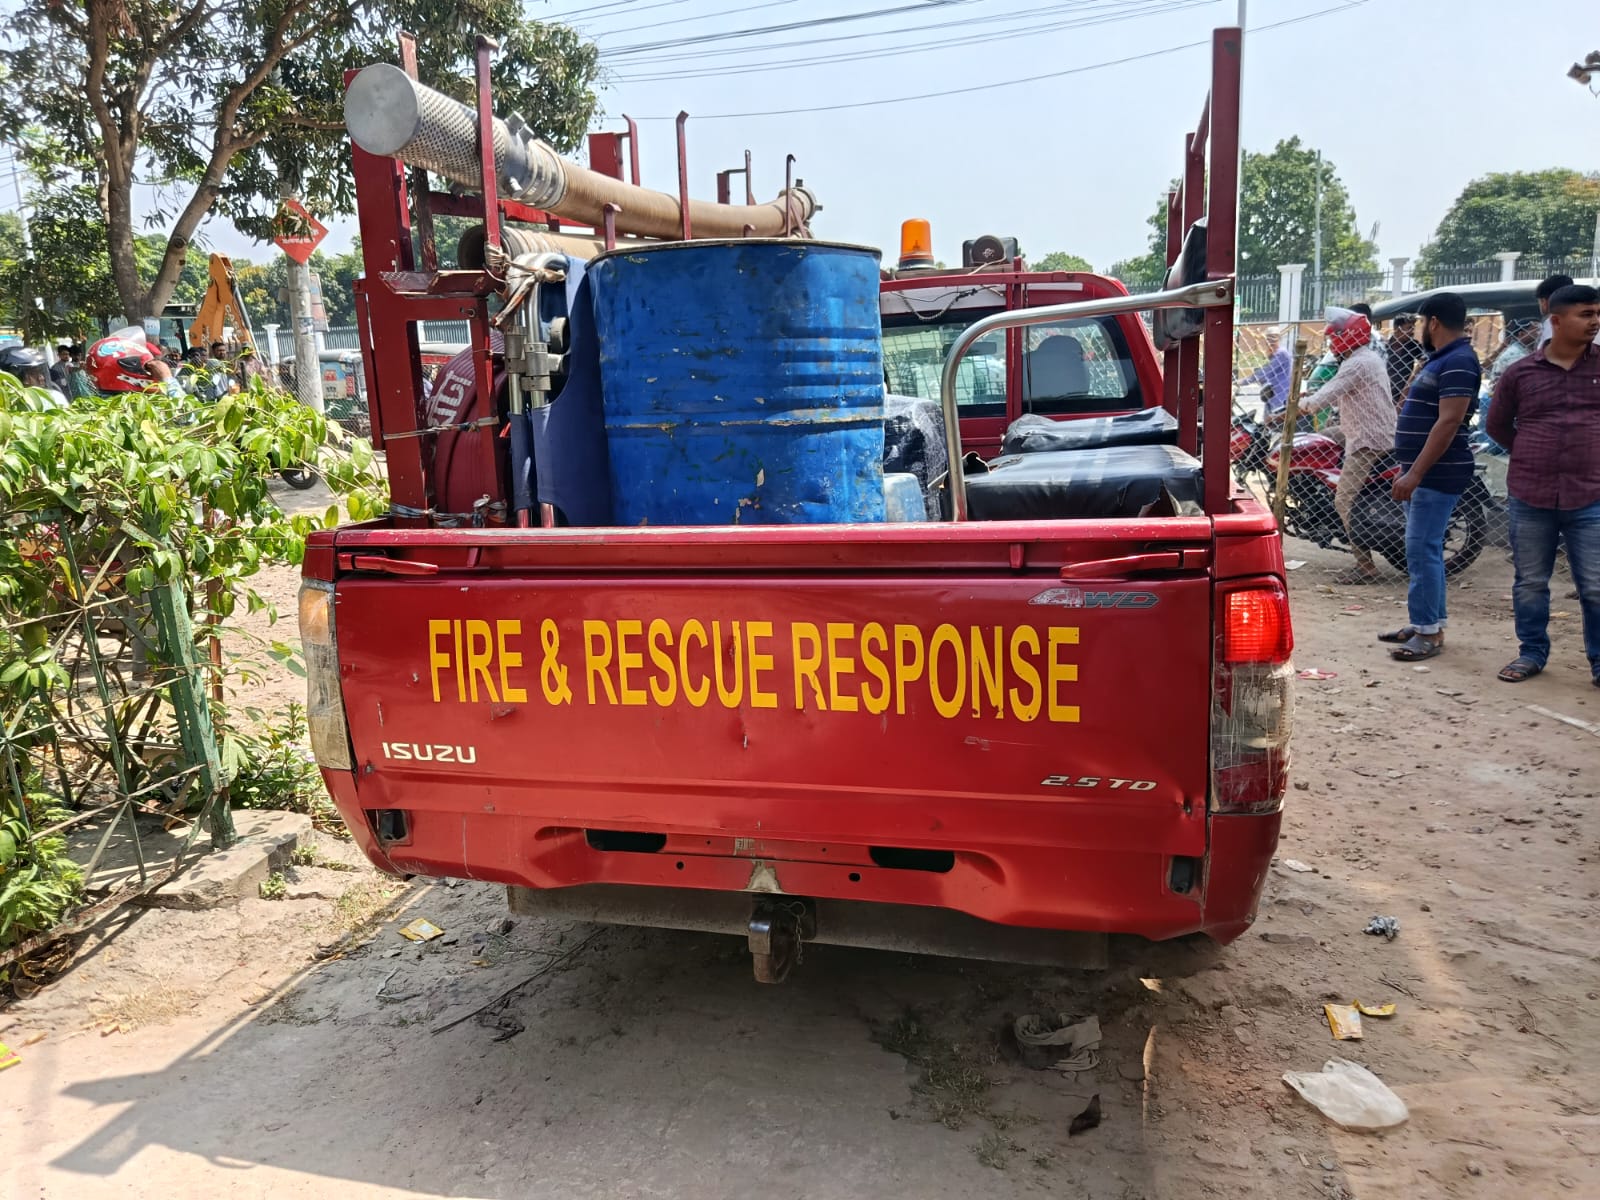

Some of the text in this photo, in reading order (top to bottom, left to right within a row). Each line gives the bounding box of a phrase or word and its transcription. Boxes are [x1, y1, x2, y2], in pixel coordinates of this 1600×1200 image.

[1028, 586, 1160, 608] 4WD
[428, 618, 1080, 723] FIRE & RESCUE RESPONSE
[382, 742, 476, 764] ISUZU
[1041, 775, 1157, 791] 2.5 TD
